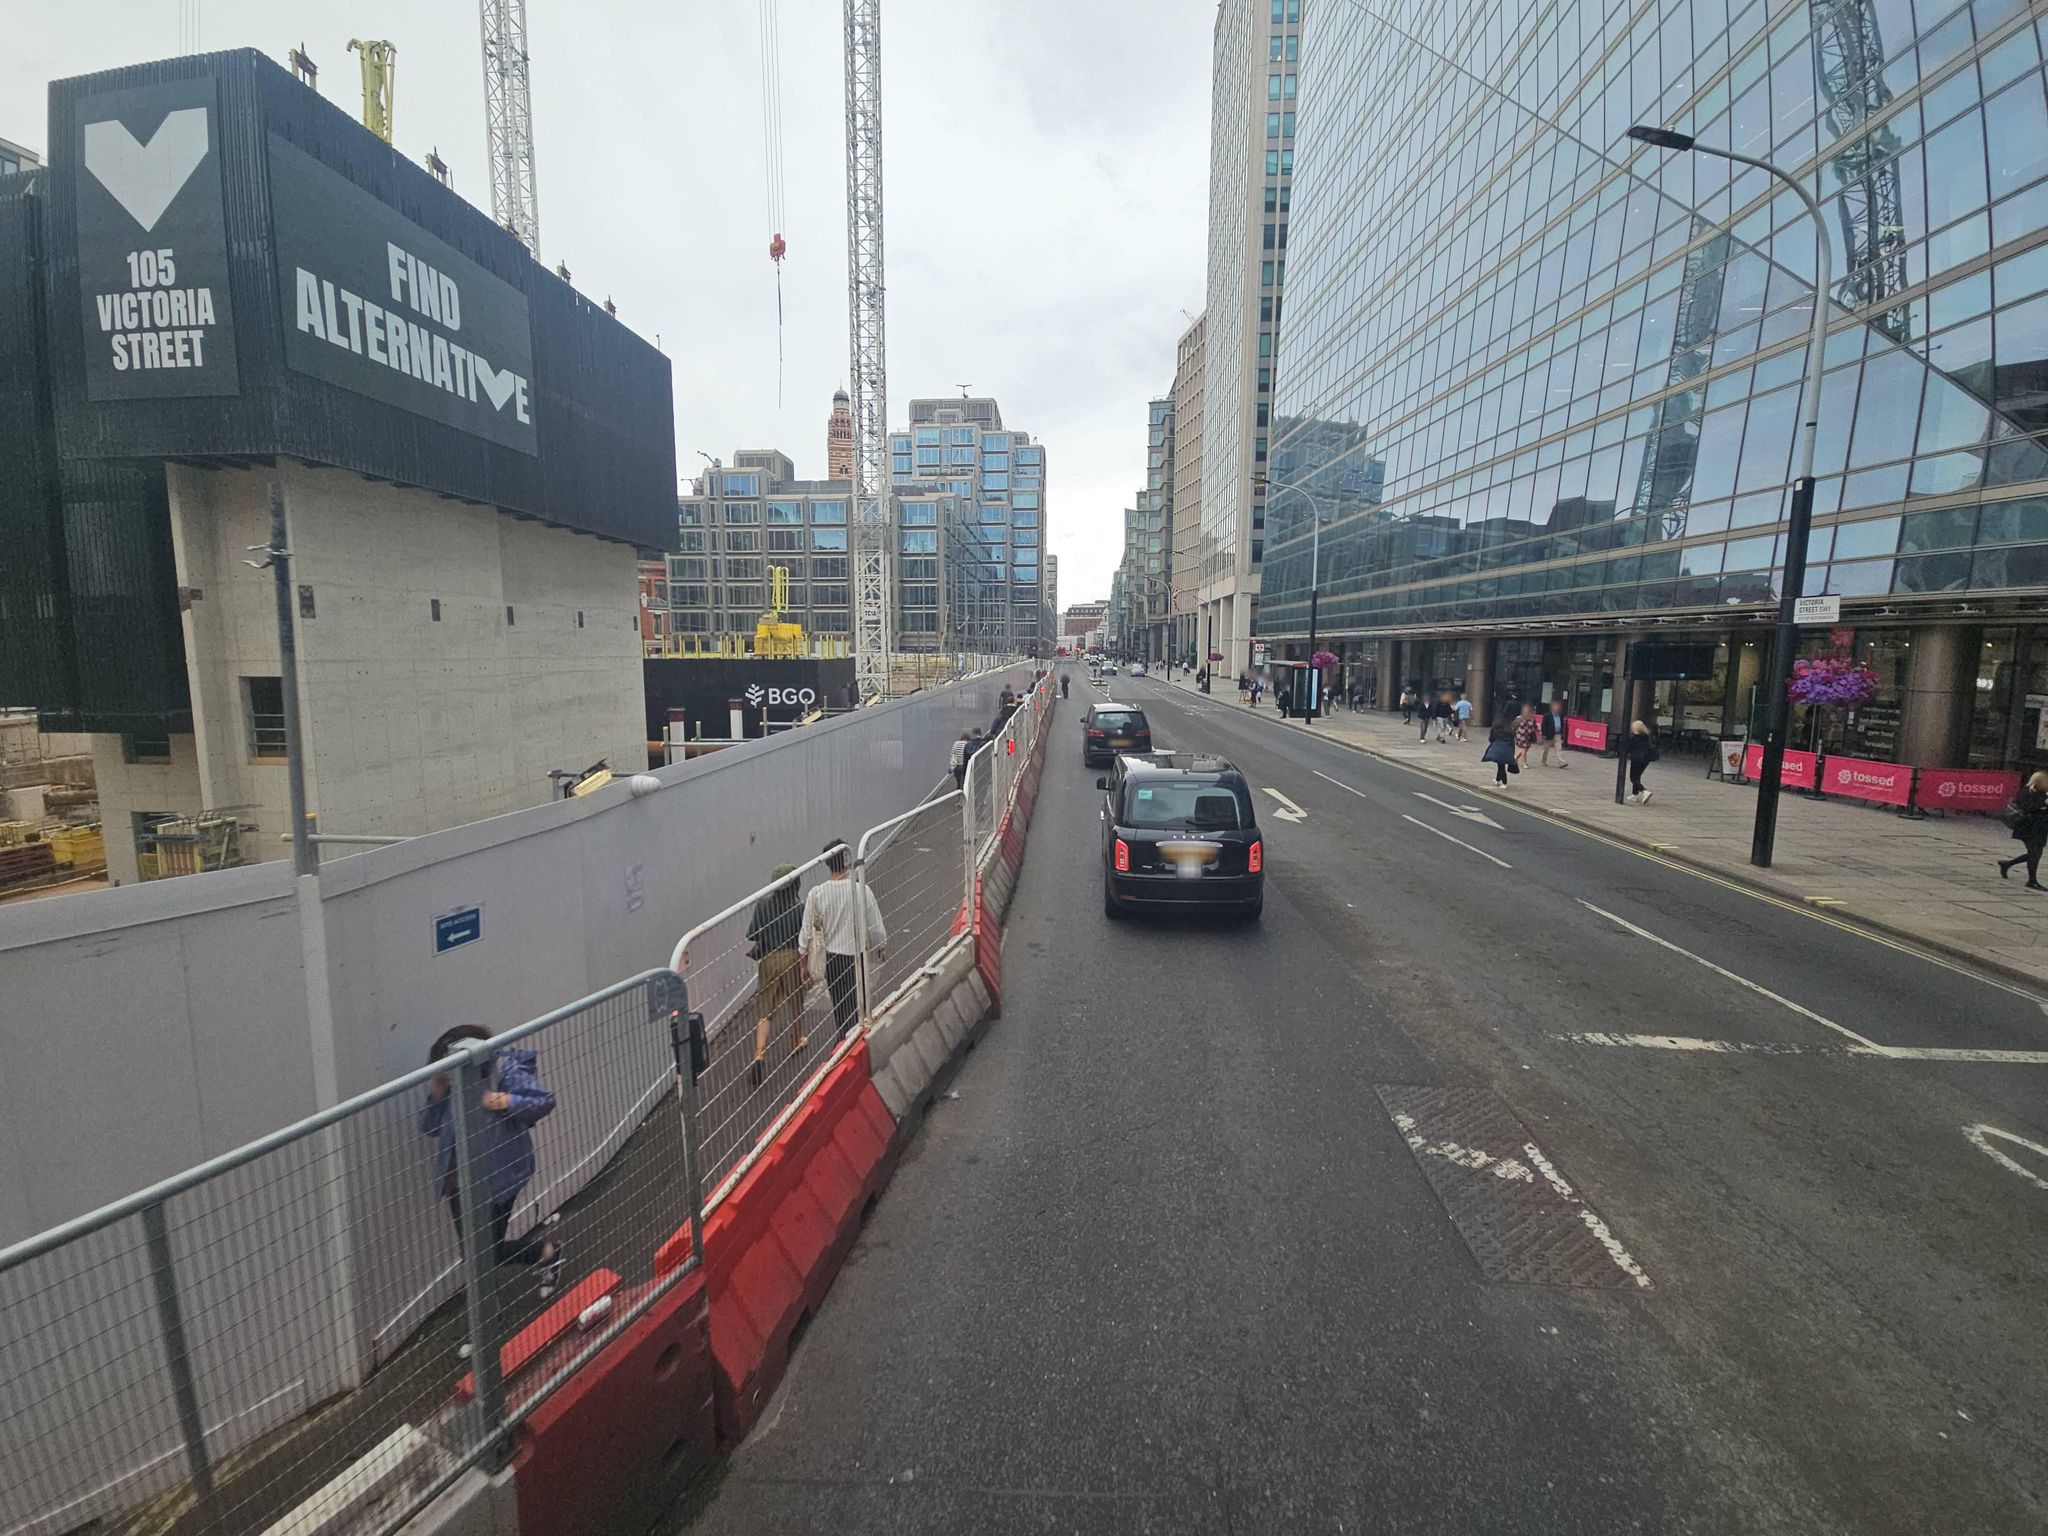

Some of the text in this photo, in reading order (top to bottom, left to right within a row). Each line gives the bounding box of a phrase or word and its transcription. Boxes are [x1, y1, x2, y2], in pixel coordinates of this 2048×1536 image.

[127, 248, 176, 288] 105
[387, 241, 461, 332] FIND
[96, 288, 216, 331] VICTORIA
[111, 330, 204, 371] STREET
[768, 687, 816, 705] BGO
[1853, 770, 1895, 787] tossed
[1958, 782, 2004, 794] tossed
